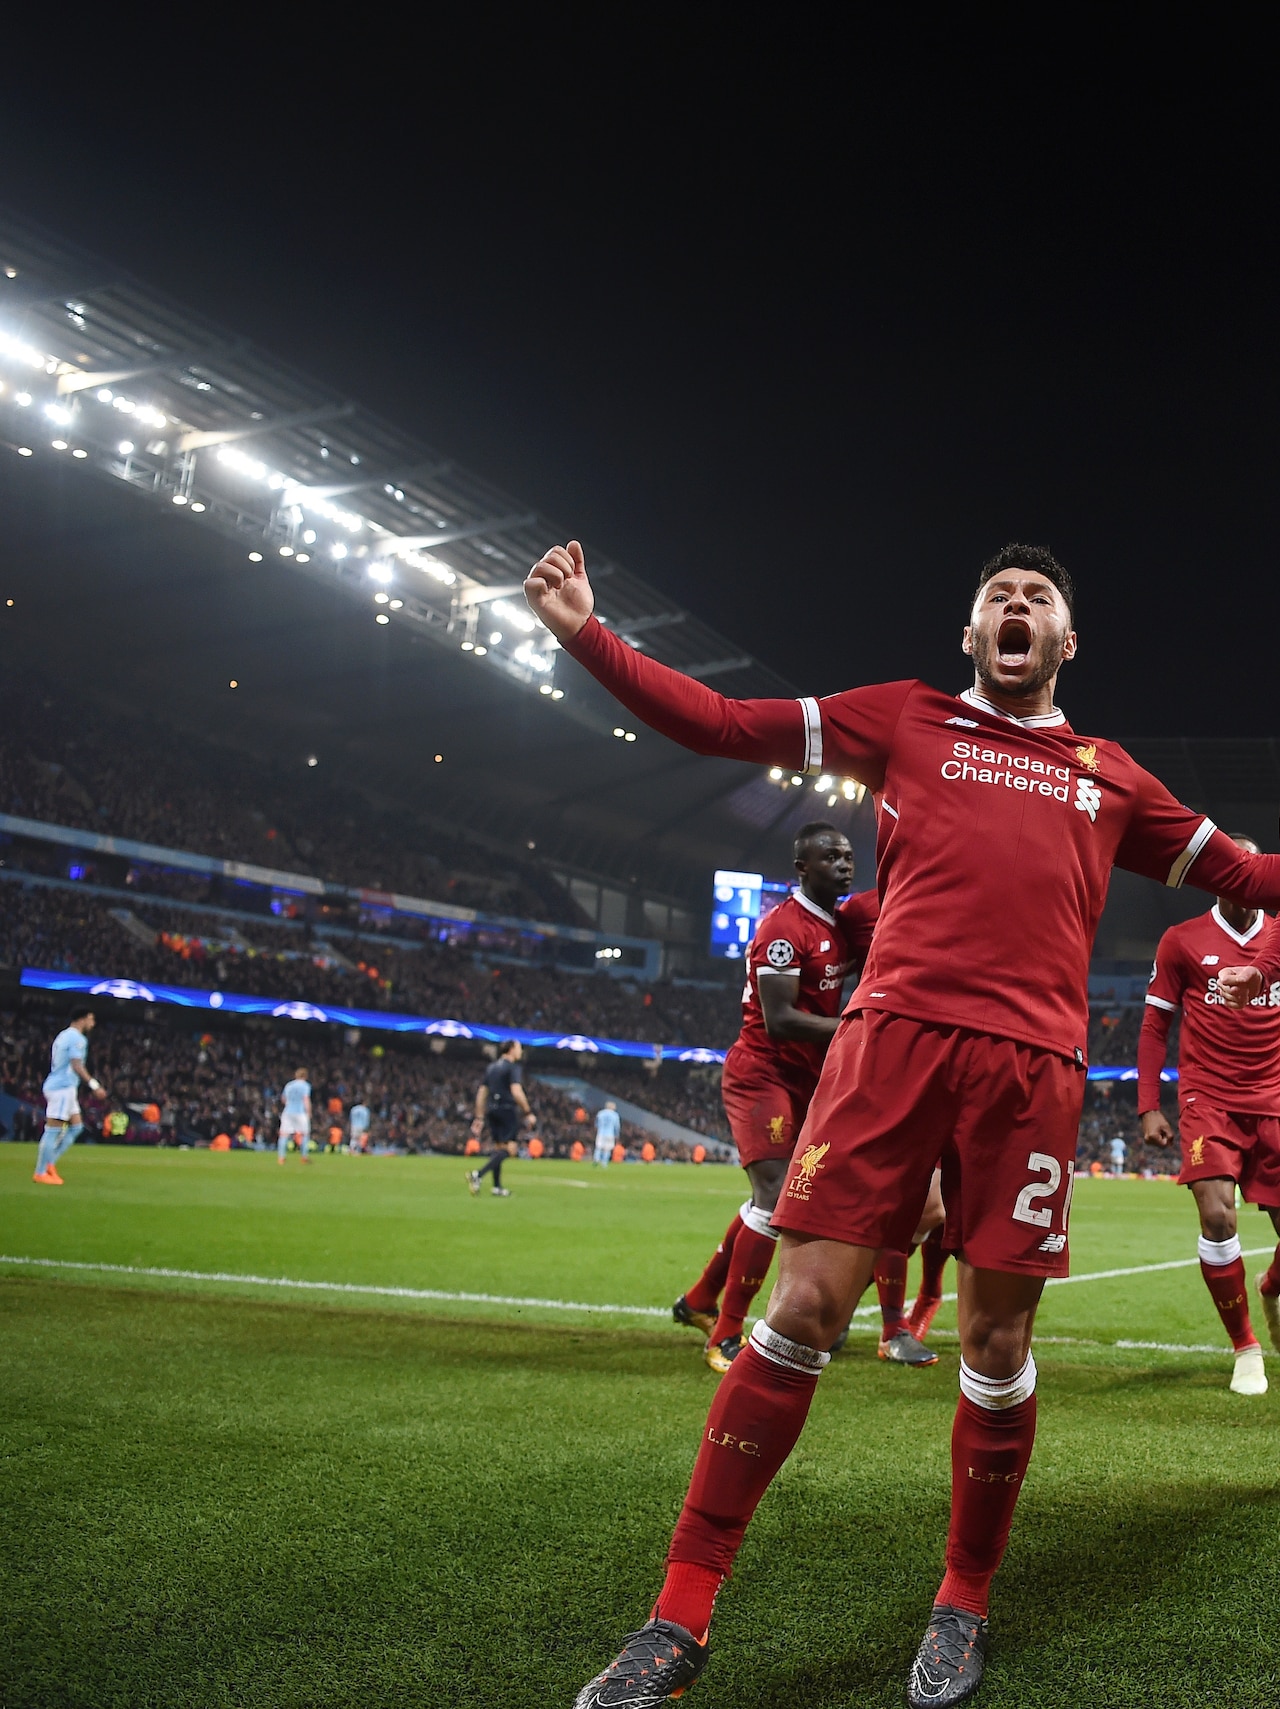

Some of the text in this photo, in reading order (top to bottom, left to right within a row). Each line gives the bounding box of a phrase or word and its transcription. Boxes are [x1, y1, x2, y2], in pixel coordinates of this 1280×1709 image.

[953, 742, 1070, 783] Standard
[941, 760, 1069, 803] Chartered
[738, 888, 751, 913] 1
[735, 917, 750, 943] 1
